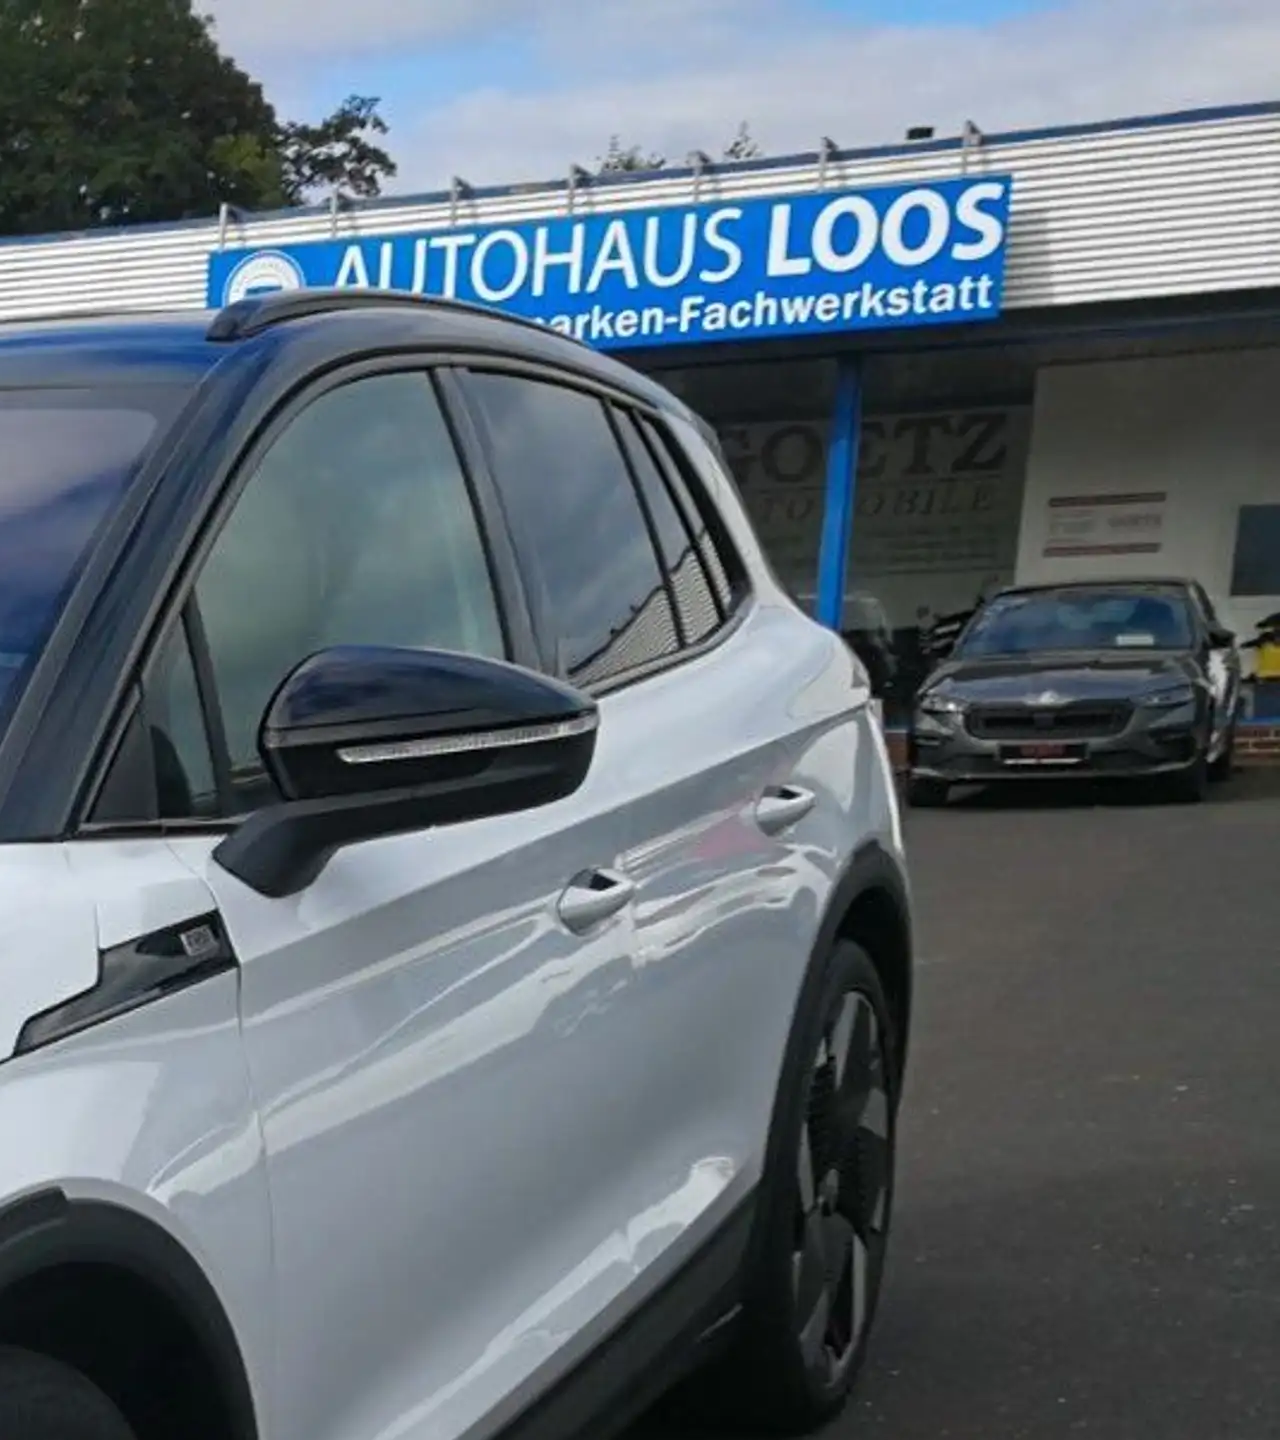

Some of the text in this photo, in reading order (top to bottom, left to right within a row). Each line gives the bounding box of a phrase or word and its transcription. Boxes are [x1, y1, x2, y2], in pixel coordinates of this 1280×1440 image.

[334, 182, 1005, 301] AUTOHAUS LOOS
[534, 273, 994, 341] arken-Fachwerkstatt
